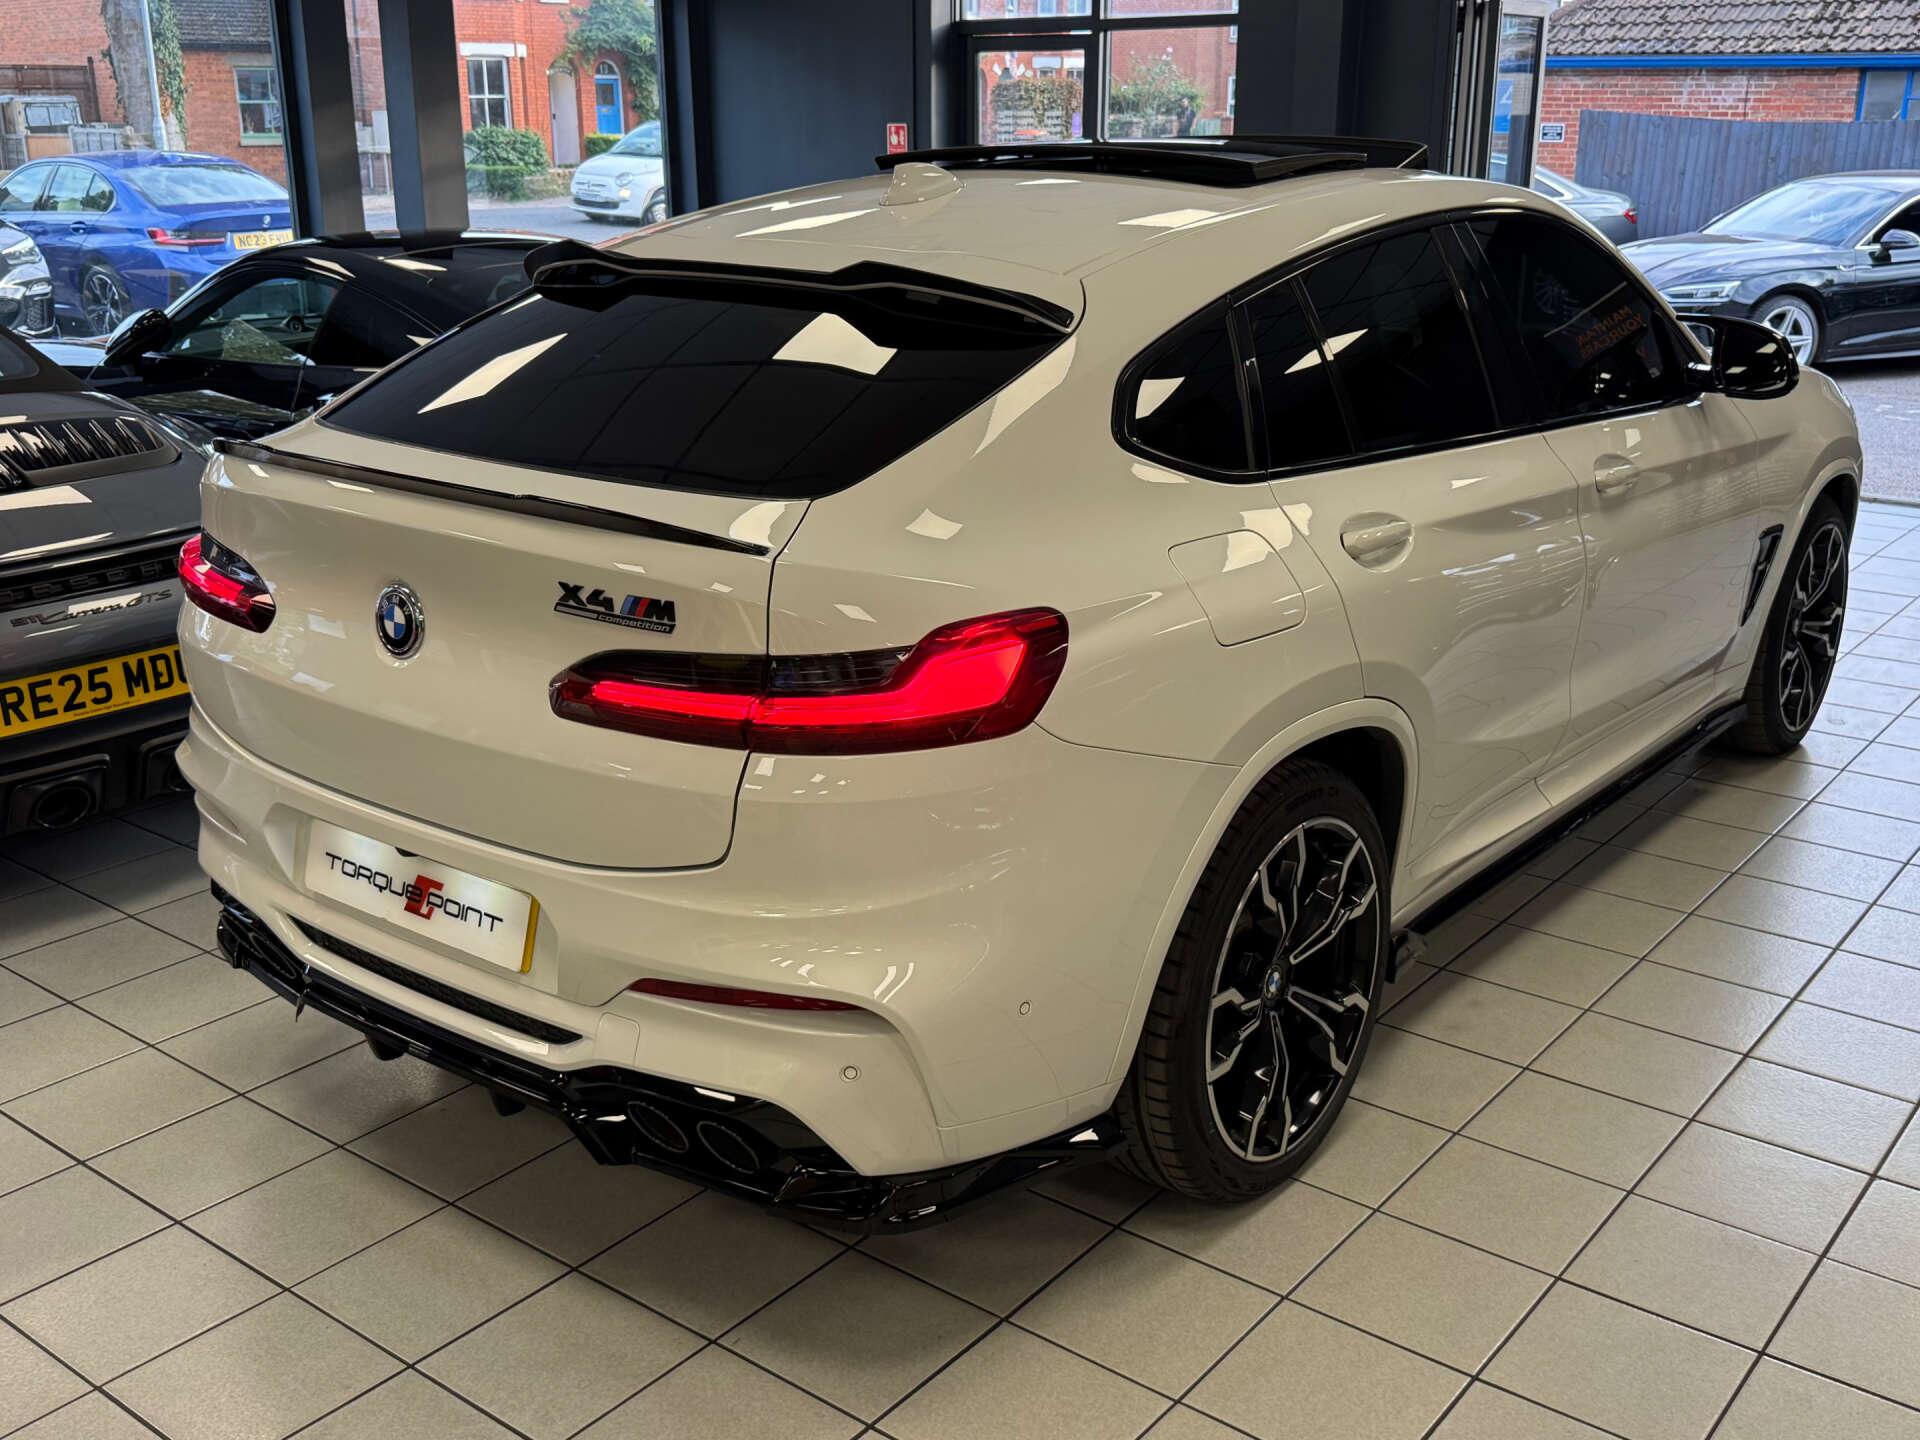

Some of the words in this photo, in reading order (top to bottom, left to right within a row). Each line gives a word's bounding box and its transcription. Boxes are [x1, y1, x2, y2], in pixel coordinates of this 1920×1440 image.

[126, 589, 172, 608] GTS
[557, 581, 615, 613] X4
[598, 613, 671, 633] competition
[0, 666, 114, 726] RE25
